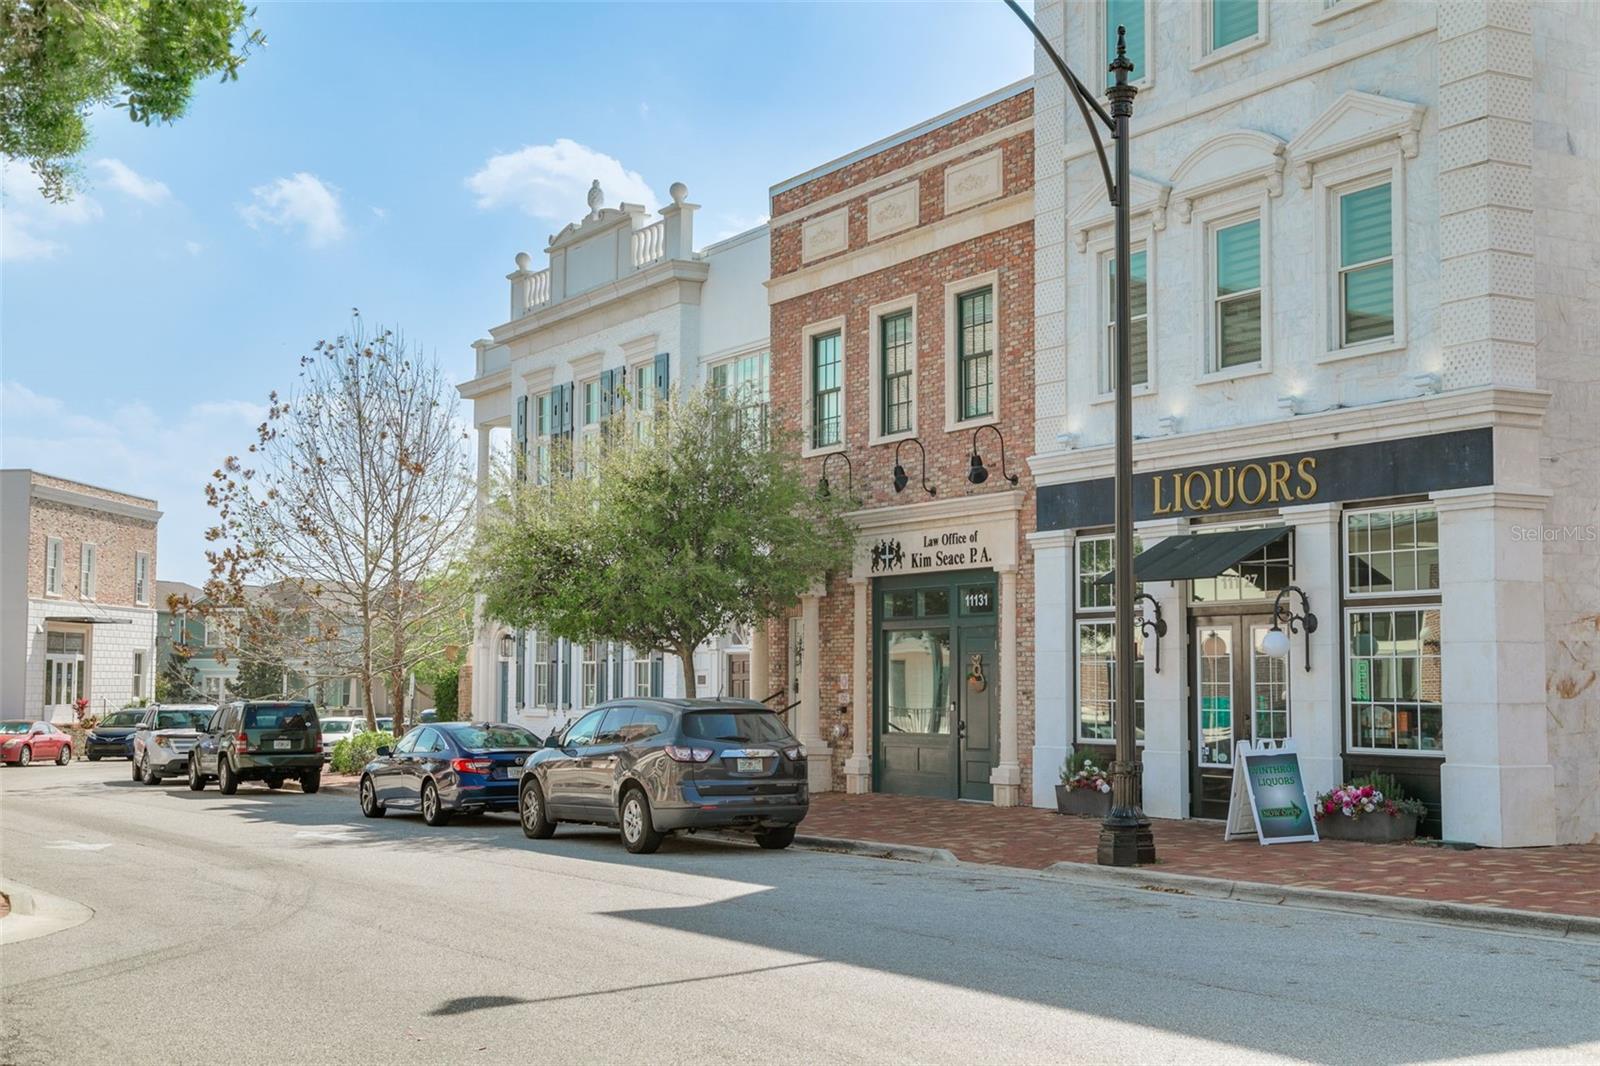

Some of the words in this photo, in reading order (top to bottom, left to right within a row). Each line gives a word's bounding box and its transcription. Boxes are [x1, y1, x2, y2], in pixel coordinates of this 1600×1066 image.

[1152, 457, 1318, 514] LIQUORS
[923, 535, 939, 548] Law
[941, 532, 967, 546] Office
[969, 530, 978, 543] of
[911, 552, 932, 568] Kim
[935, 550, 965, 567] Seace
[965, 593, 988, 607] 11131
[1258, 776, 1295, 787] LIQUORS
